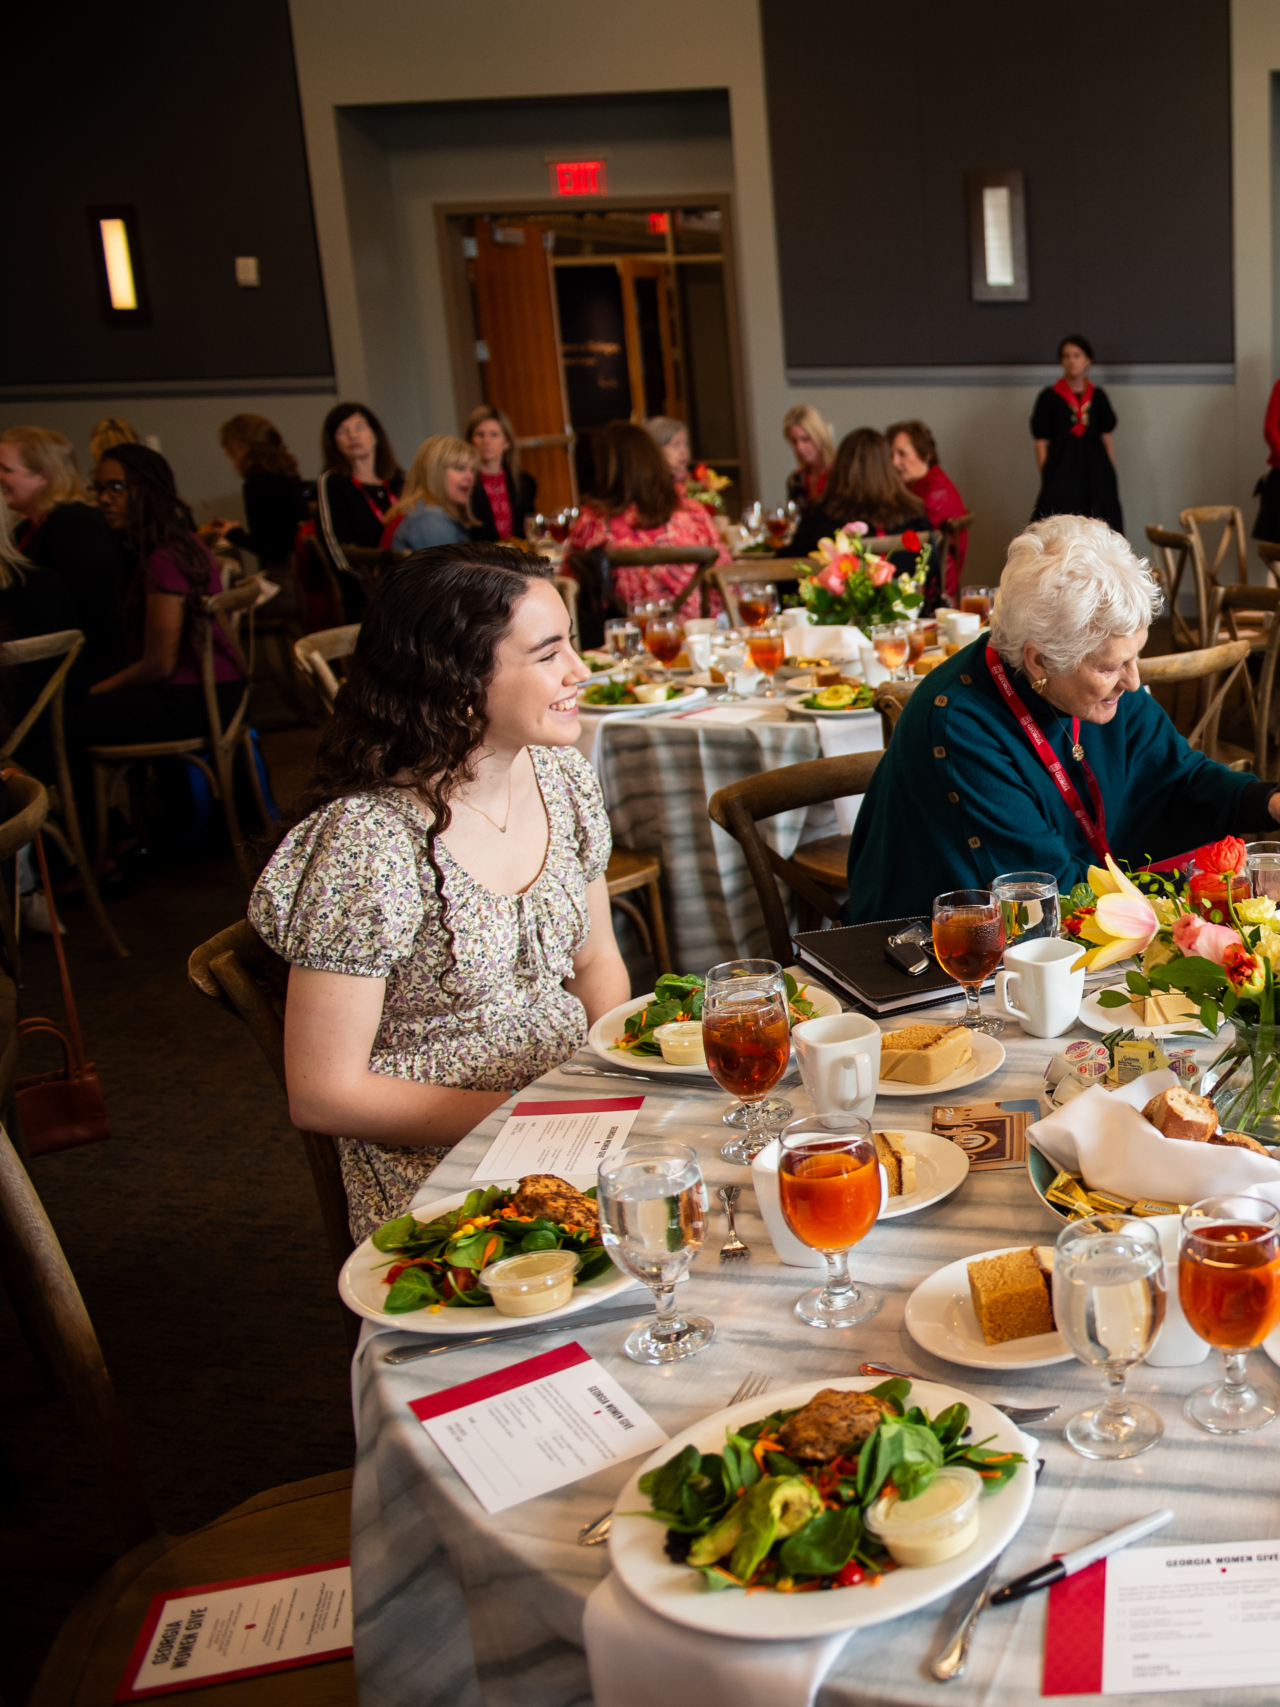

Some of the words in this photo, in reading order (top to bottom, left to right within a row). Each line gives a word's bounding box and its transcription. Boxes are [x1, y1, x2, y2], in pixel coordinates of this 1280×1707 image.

[556, 162, 600, 195] EXIT
[1026, 723, 1042, 746] GEORGIA
[1054, 771, 1069, 792] GEORGIA
[587, 1385, 610, 1405] GEORGIA
[605, 1402, 623, 1420] WOMEN
[618, 1418, 635, 1430] GIVE
[1166, 1557, 1212, 1568] GEORGIA
[1216, 1555, 1253, 1565] WOMEN
[1256, 1553, 1280, 1562] GIVE
[152, 1620, 183, 1666] GEORGIA
[170, 1629, 198, 1671] WOMEN
[190, 1606, 208, 1631] GIVE
